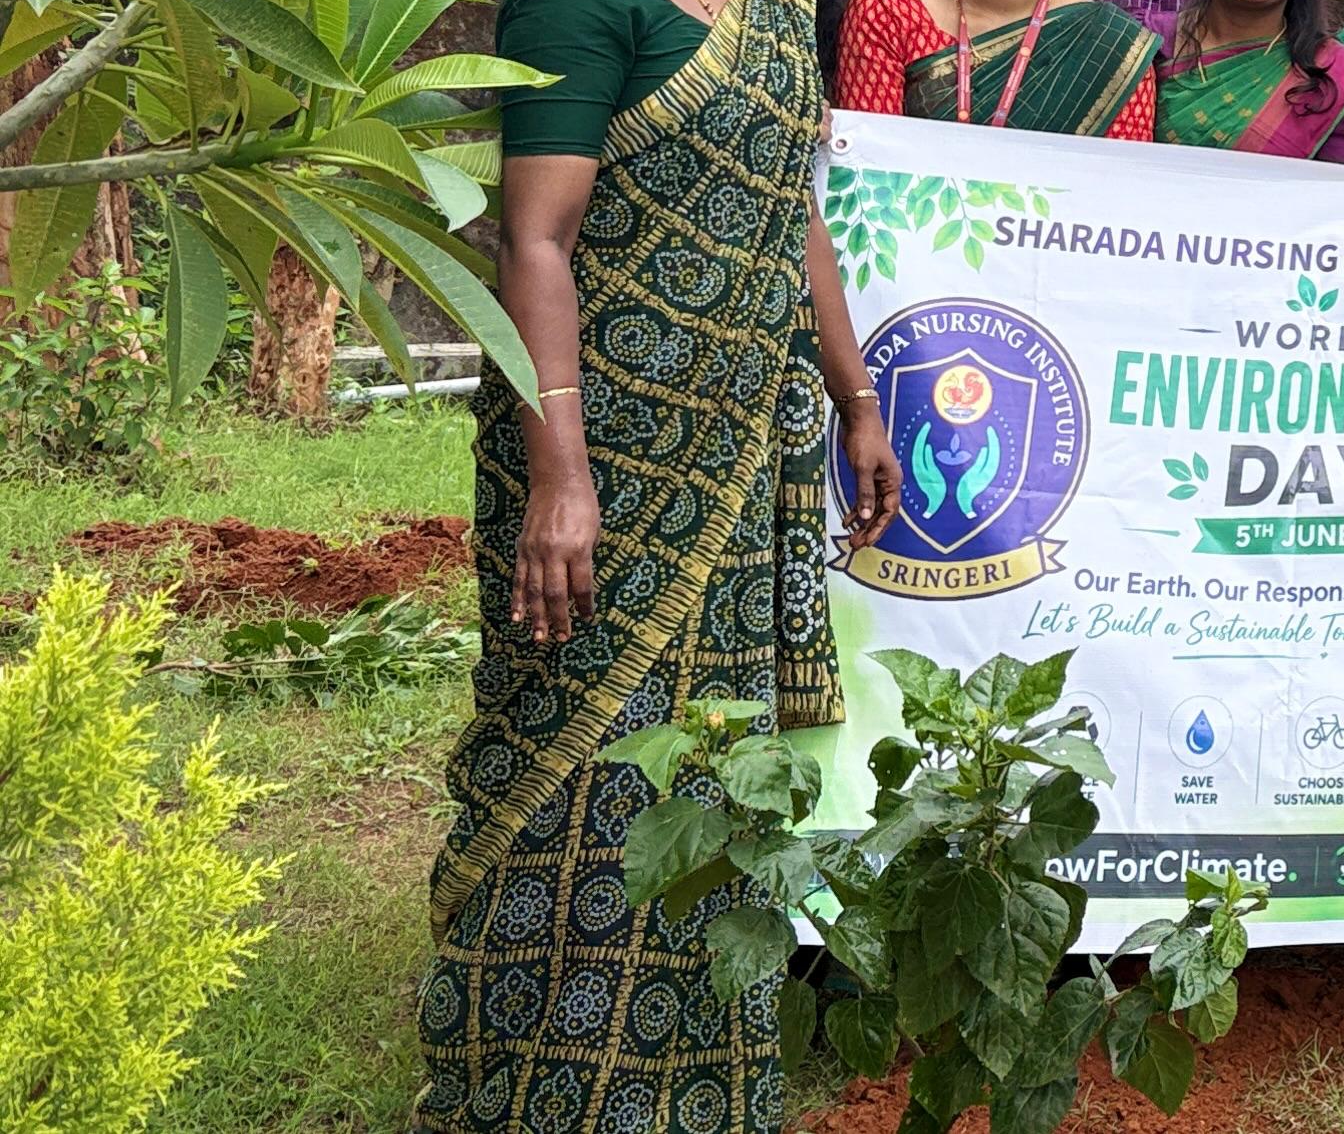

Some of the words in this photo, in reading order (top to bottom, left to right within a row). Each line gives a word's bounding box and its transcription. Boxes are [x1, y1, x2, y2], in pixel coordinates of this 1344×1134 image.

[993, 216, 1165, 261] SHARADA
[1175, 233, 1338, 273] NURSING
[910, 312, 1027, 349] NURSING
[1024, 341, 1075, 467] INSTITUTE
[1235, 524, 1274, 548] 5TH
[877, 559, 1012, 589] SRINGERI
[1074, 568, 1120, 593] Our
[1127, 571, 1197, 599] Earth.
[1204, 578, 1249, 602] Our
[1021, 599, 1079, 640] Let's
[1085, 603, 1161, 640] Build
[1164, 622, 1181, 636] a
[1186, 609, 1316, 646] Sustainable
[1181, 776, 1214, 788] SAVE
[1174, 793, 1218, 805] WATER
